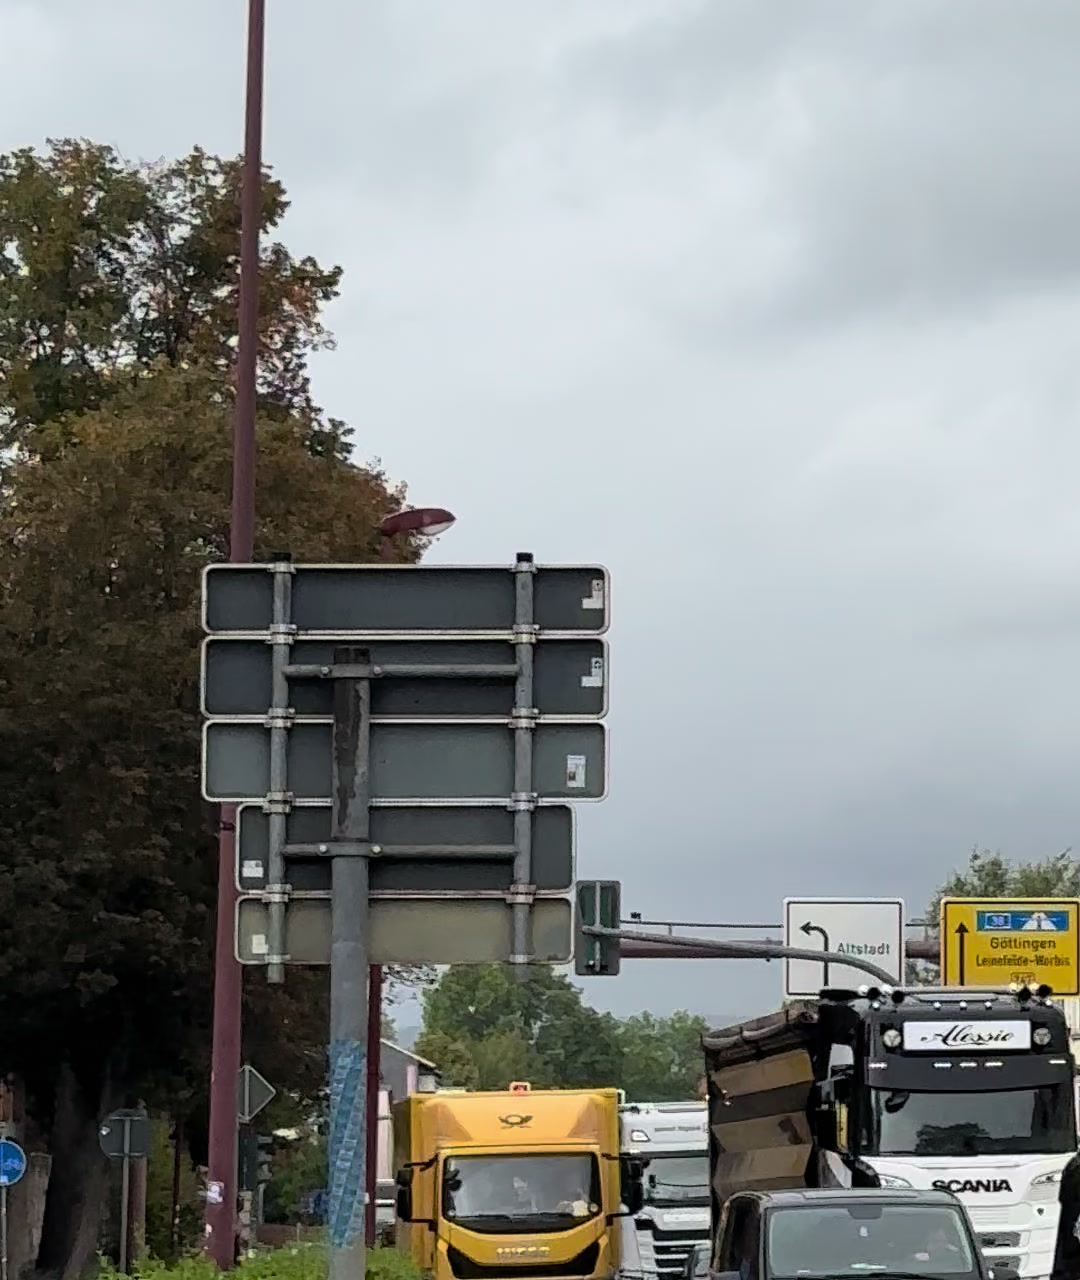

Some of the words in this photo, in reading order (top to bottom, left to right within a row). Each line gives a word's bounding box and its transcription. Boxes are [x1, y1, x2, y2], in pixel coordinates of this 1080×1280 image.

[837, 942, 891, 956] Altstadt
[990, 936, 1057, 951] Göttingen
[931, 1178, 1013, 1194] SCANIA
